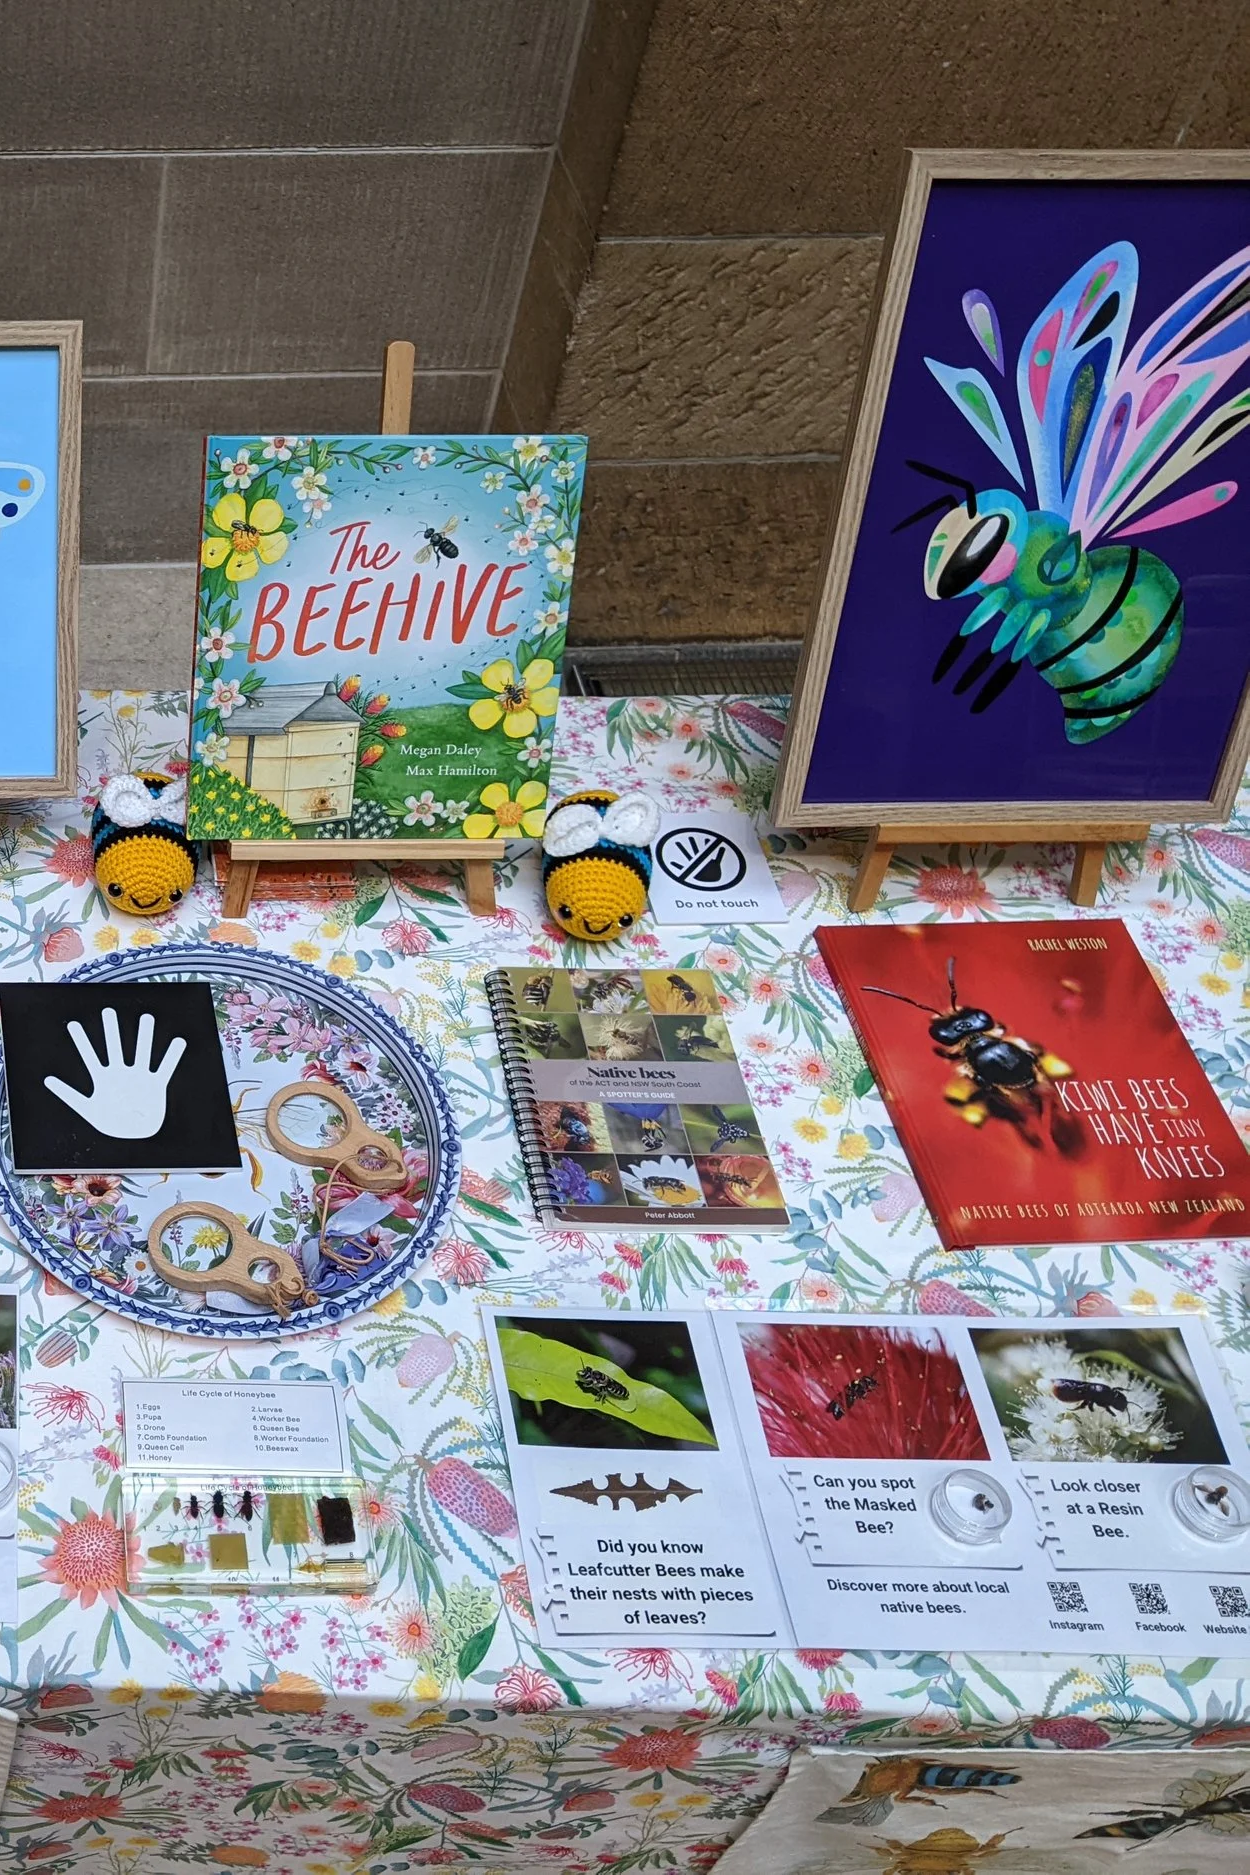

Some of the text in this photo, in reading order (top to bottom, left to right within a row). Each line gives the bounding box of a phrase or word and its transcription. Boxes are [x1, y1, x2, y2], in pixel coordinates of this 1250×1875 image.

[329, 521, 400, 575] The
[246, 563, 529, 663] BEEHIVE
[400, 744, 482, 758] Megan Daley
[405, 765, 497, 776] Max Hamilton
[675, 898, 759, 909] Do not touch
[1027, 938, 1107, 951] RACHEL WESTON
[587, 1067, 676, 1079] Native bees
[1055, 1078, 1189, 1112] KIWI BEES
[1088, 1113, 1205, 1144] HAVE TINY
[1135, 1145, 1225, 1179] KNEES
[960, 1199, 1245, 1219] NATIVE BEES OF AOTEAROA NEW ZEALAND
[199, 1390, 223, 1399] Cycle
[138, 1454, 172, 1462] 11.Honey
[813, 1475, 915, 1492] Can you spot
[1050, 1479, 1140, 1493] Look closer
[825, 1498, 917, 1511] the Masked
[1067, 1503, 1144, 1515] at a Resin
[856, 1521, 894, 1534] Bee?
[1092, 1525, 1129, 1538] Bee.
[597, 1539, 703, 1556] Did you know
[568, 1563, 744, 1577] Leafcutter Bees make
[570, 1587, 753, 1603] their nests with pieces
[624, 1610, 706, 1624] of leaves?
[1049, 1620, 1104, 1632] Instagram
[1135, 1622, 1187, 1633] Facebook
[1203, 1624, 1246, 1634] Website
